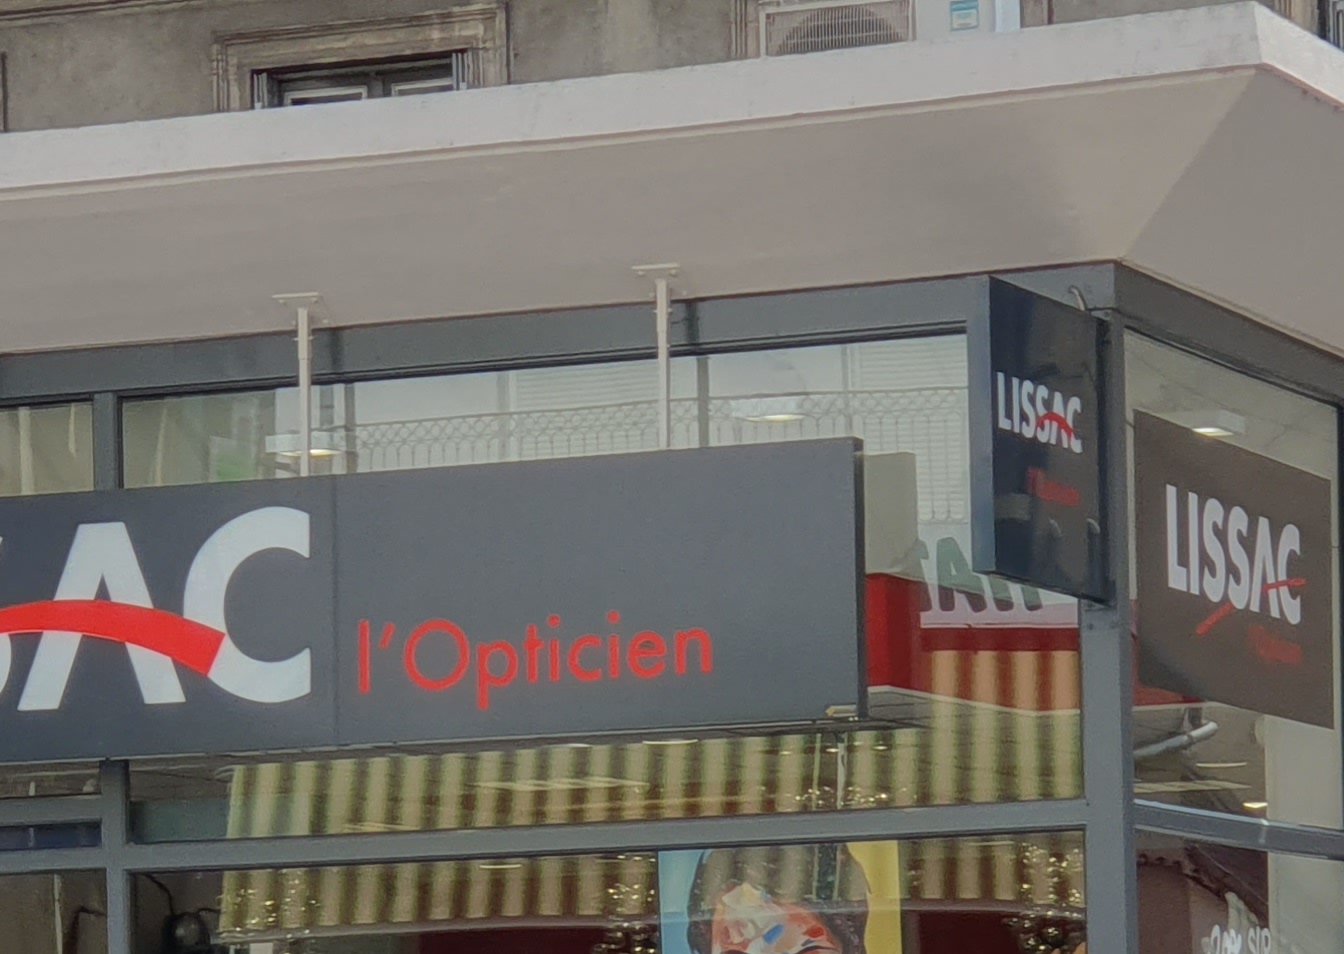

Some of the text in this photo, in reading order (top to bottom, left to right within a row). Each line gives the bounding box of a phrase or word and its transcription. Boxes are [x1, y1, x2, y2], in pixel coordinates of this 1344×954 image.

[997, 371, 1083, 454] LISSAC
[1165, 483, 1302, 625] LISSAC
[358, 611, 713, 710] l'Opticien
